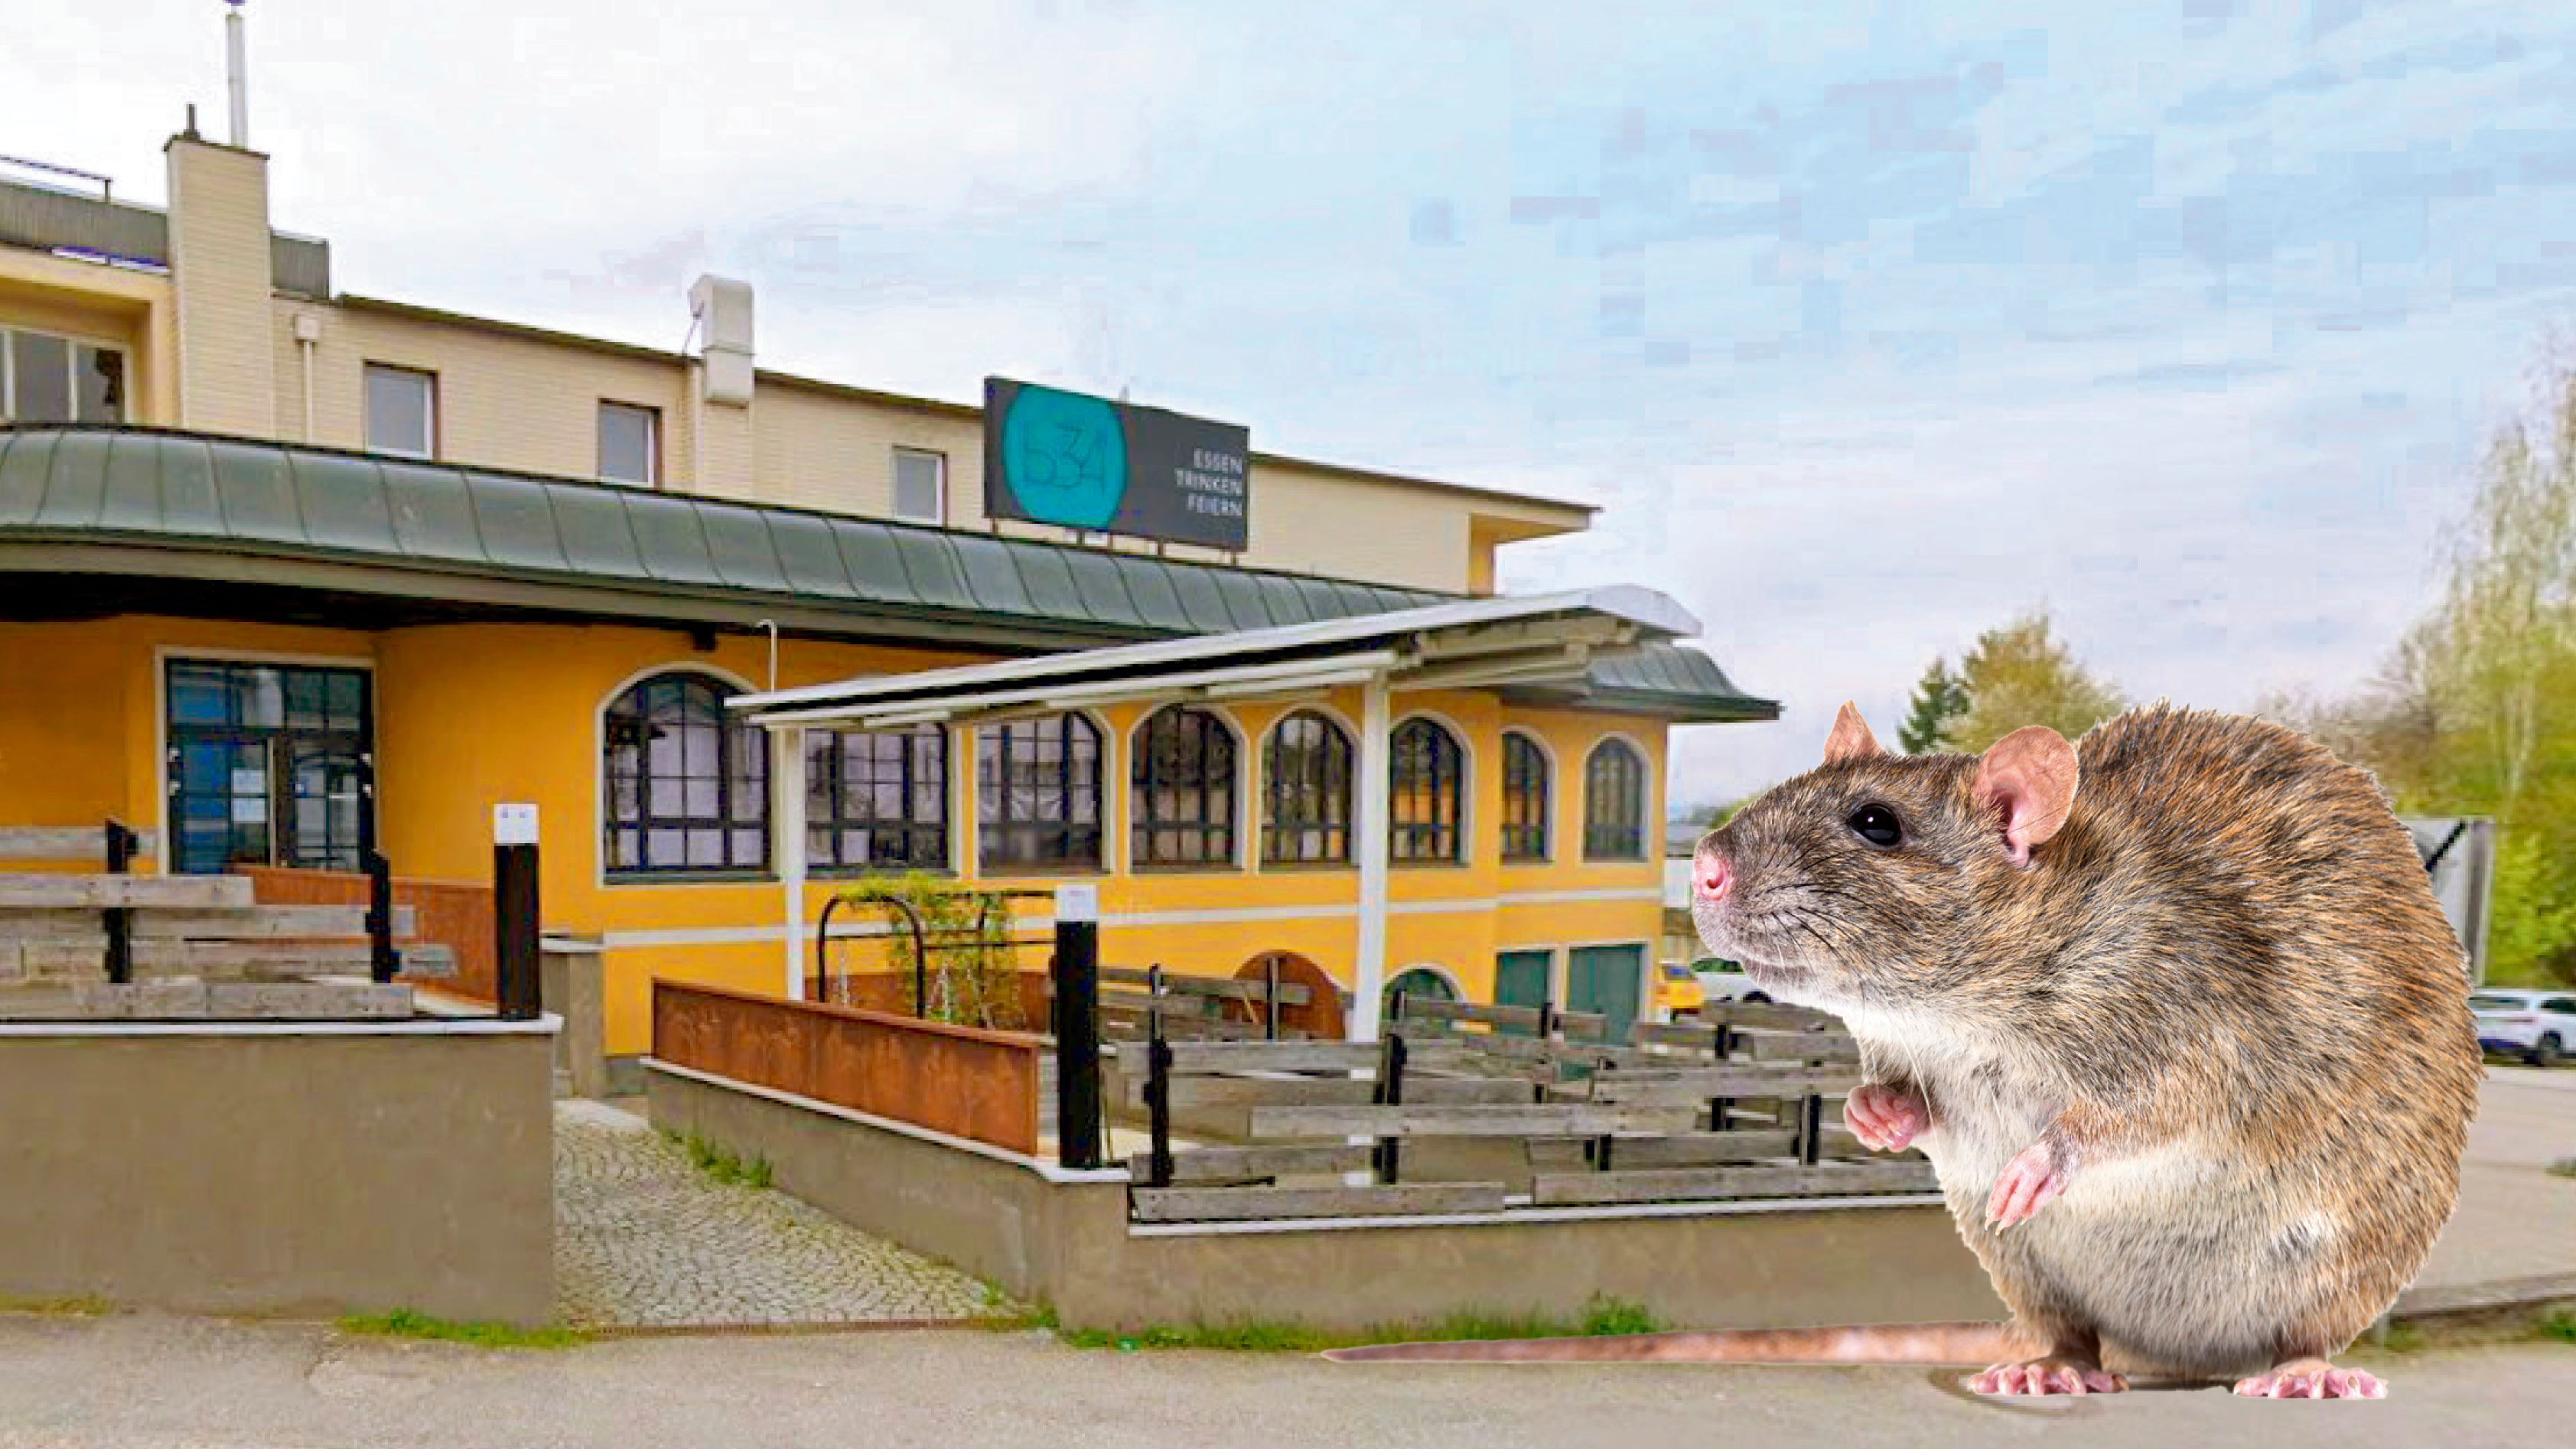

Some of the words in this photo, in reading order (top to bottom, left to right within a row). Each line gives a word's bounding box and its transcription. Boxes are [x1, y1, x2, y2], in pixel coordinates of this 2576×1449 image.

[1193, 448, 1242, 476] ESSEN
[1175, 467, 1242, 496] TRINKEN
[1187, 492, 1242, 517] FEIERN
